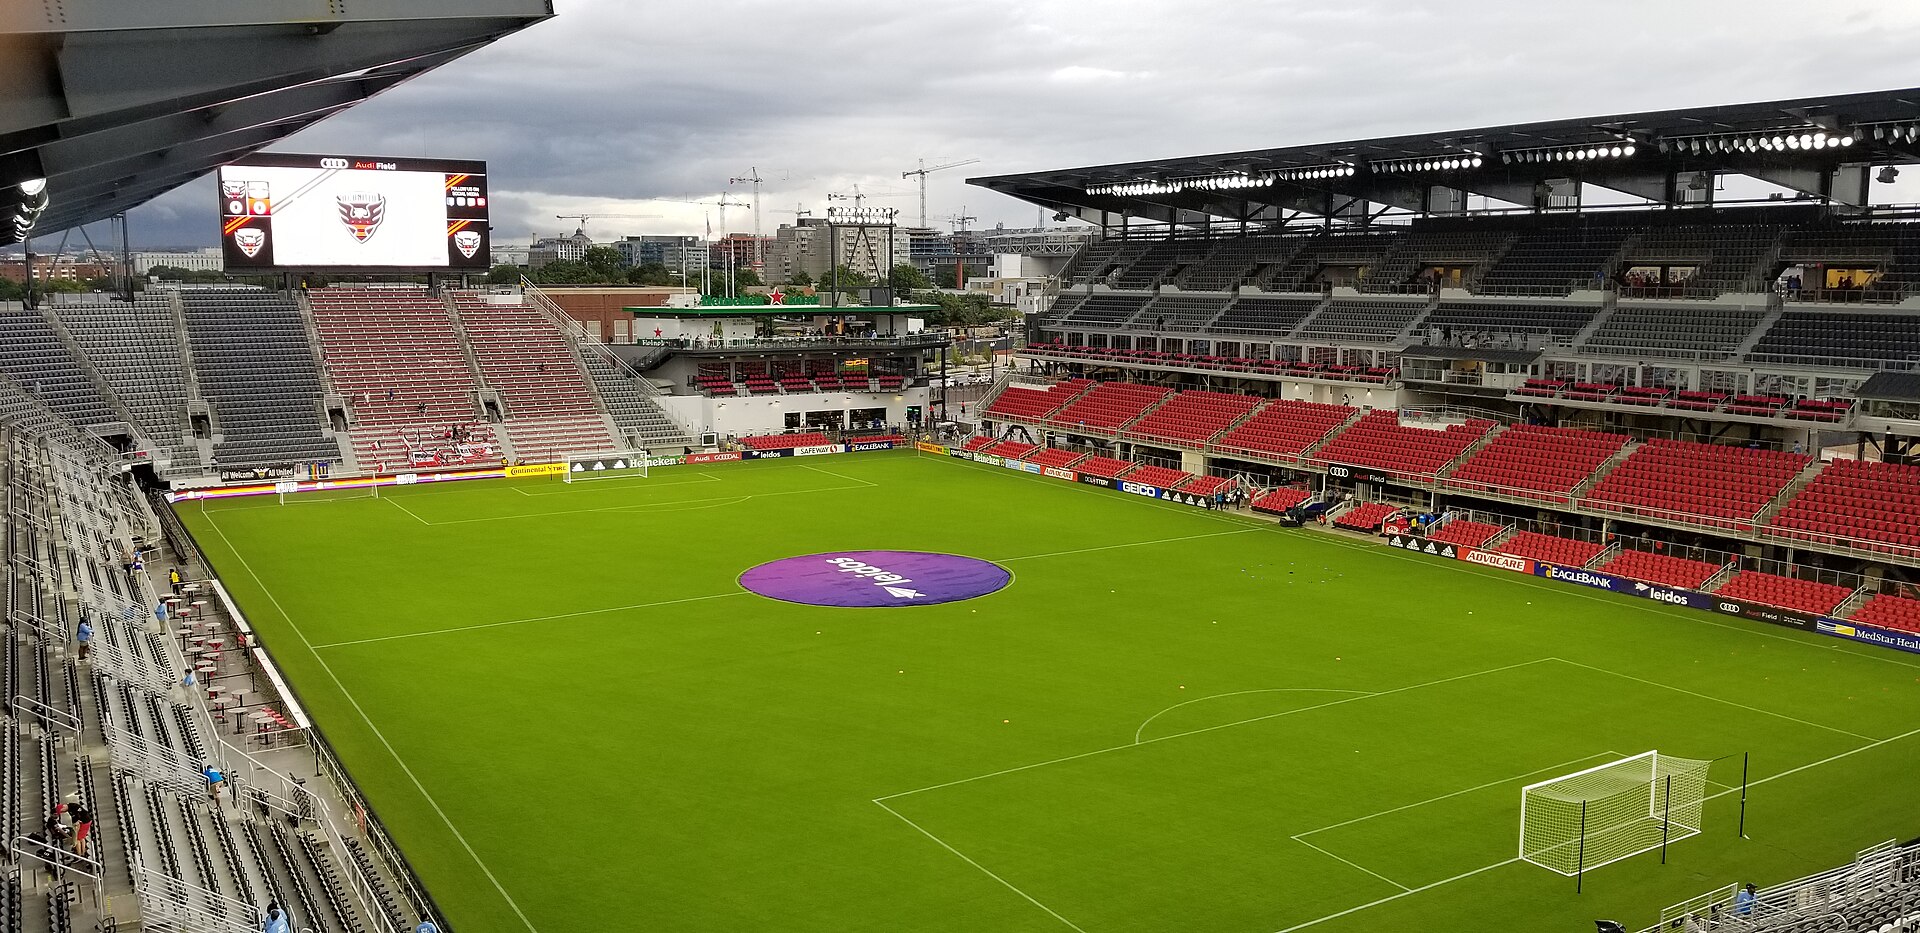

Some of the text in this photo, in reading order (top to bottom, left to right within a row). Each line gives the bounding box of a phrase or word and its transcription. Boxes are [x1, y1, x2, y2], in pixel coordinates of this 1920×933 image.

[355, 161, 396, 170] Audi Field
[701, 295, 764, 306] Heineken
[760, 450, 781, 459] leidos
[800, 446, 829, 455] SAFEWAY
[629, 456, 677, 468] Heineken
[973, 452, 1000, 466] Heineken
[221, 469, 254, 479] All Welcome
[268, 467, 293, 477] All United
[510, 465, 546, 476] Continental
[1353, 472, 1385, 483] Audi Field
[1122, 482, 1156, 497] GEICO
[1468, 552, 1524, 571] ADVOCARE
[825, 557, 912, 586] leidos
[1650, 588, 1688, 605] leidos
[1761, 612, 1778, 620] Field
[1856, 629, 1920, 650] MedStar Heal
